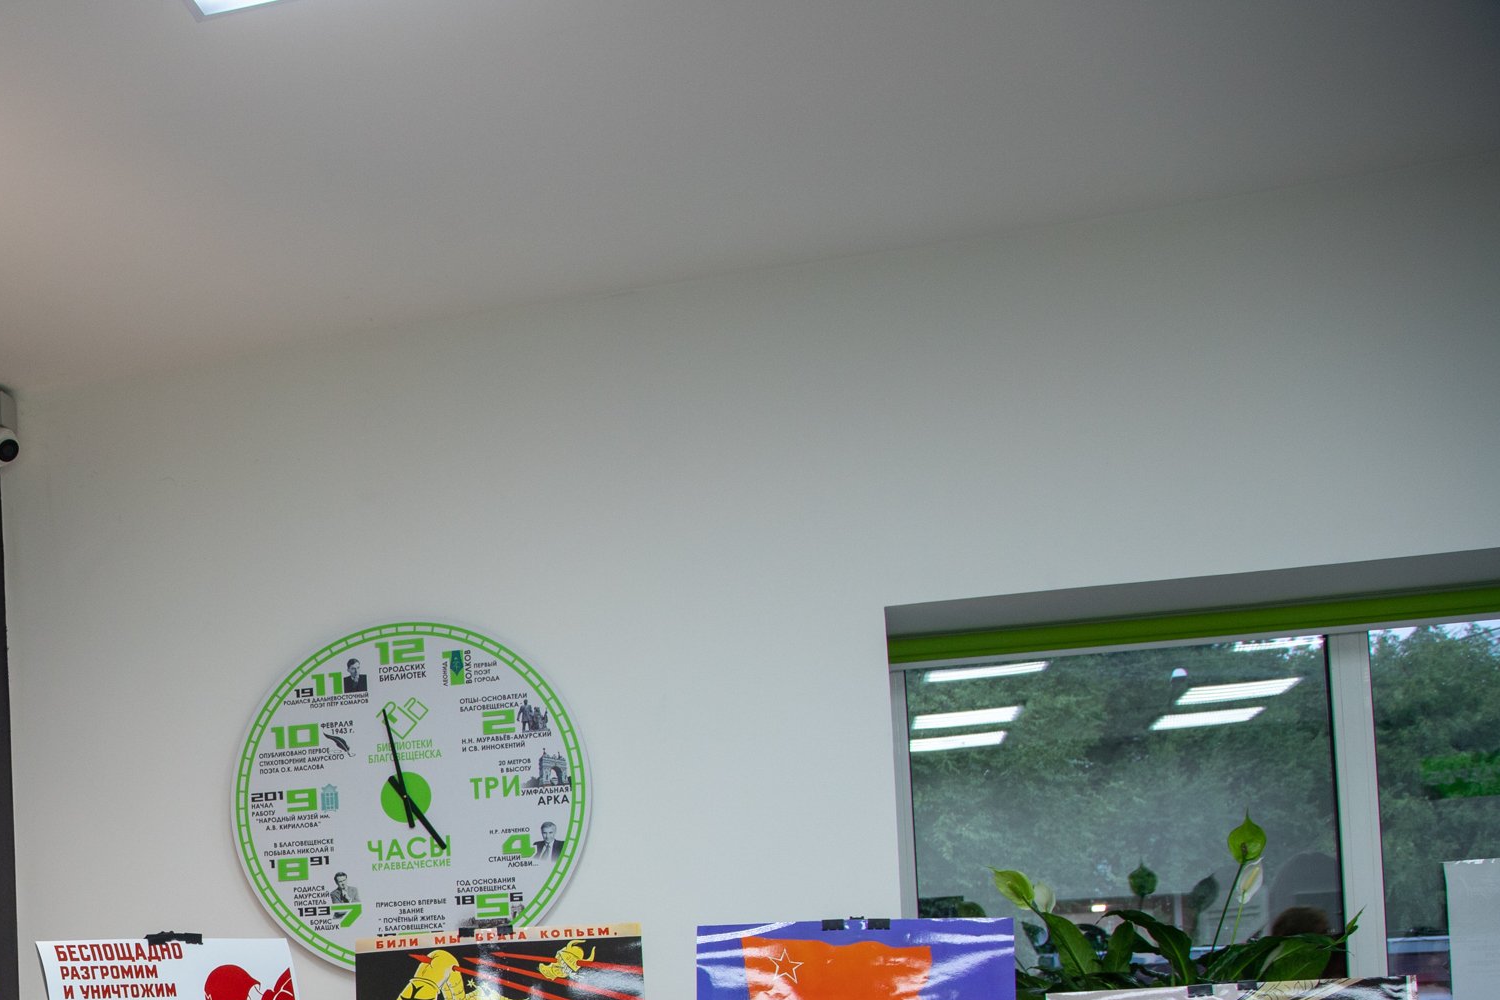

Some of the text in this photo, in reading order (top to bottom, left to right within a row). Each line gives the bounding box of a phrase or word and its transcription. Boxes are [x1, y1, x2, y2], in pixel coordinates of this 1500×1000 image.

[374, 638, 425, 665] 12
[378, 663, 426, 674] ГОРОДСКИХ
[464, 650, 473, 684] ВОЛКОВ
[473, 661, 498, 669] ПЕРВЫЙ
[379, 671, 427, 682] БИБЛИОТЕК
[460, 692, 528, 705] ОТЦЫ-ОСНОВАТЕЛИ
[460, 702, 519, 712] БЛАГОВЕЩЕНСКА
[320, 720, 353, 729] ФЕВРАЛЯ
[482, 709, 516, 735] 2
[271, 723, 319, 749] 10
[481, 741, 525, 751] ИННОКЕНТИЙ
[259, 747, 330, 759] ОПУБЛИКОВАНО ПЕРВОЕ
[259, 754, 345, 767] СТИХОТВОРЕНИЕ АМУРСКОГО
[537, 794, 570, 805] АРКА
[297, 812, 319, 820] МУЗЕЙ
[279, 838, 334, 848] БЛАГОВЕЩЕНСКЕ
[367, 835, 451, 861] ЧАСЫ
[502, 834, 536, 859] 4
[264, 849, 296, 857] ПОБЫВАЛ
[297, 846, 329, 855] НИКОЛАЙ
[488, 855, 521, 863] СТАНЦИИ
[371, 859, 451, 872] КРАЕВЕДЧЕСКИЕ
[472, 877, 516, 885] ОСНОВАНИЯ
[293, 885, 325, 893] РОДИЛСЯ
[457, 883, 517, 893] БЛАГОВЕЩЕНСКА
[293, 891, 330, 899] АМУРСКИЙ
[294, 899, 327, 907] ПИСАТЕЛЬ
[375, 898, 447, 908] ПРИСВОЕНО ВПЕРВЫЕ
[399, 907, 424, 915] ЗВАНИЕ
[419, 914, 446, 922] ЖИТЕЛЬ
[376, 938, 419, 949] БИЛИ
[435, 935, 461, 945] МЫ
[540, 927, 618, 939] КОПЬЕМ.
[54, 943, 183, 962] БЕСПОЩАДНО
[60, 964, 159, 980] РАЗГРОМИМ
[63, 983, 177, 999] И УНИЧТОЖИМ
